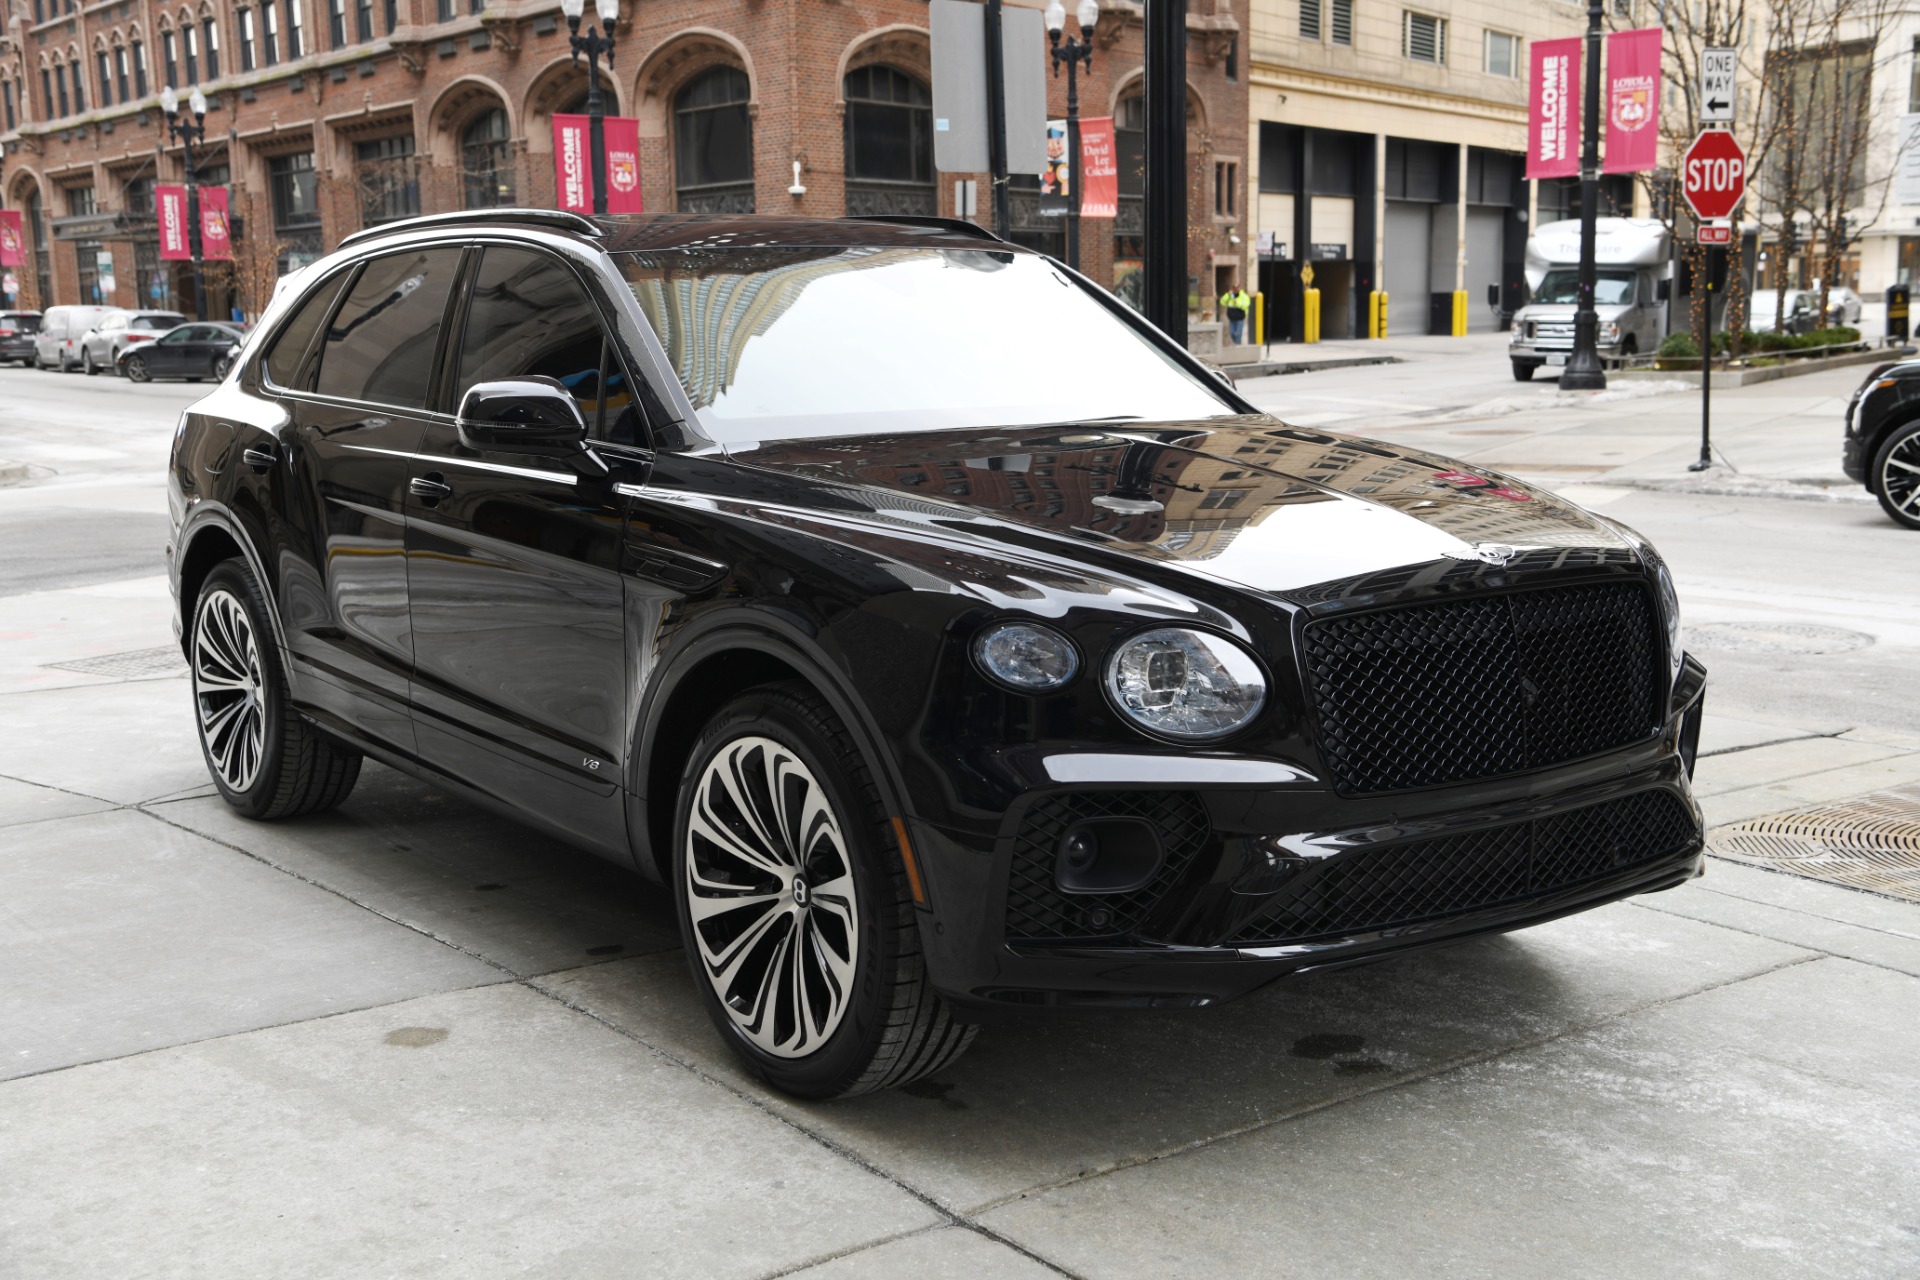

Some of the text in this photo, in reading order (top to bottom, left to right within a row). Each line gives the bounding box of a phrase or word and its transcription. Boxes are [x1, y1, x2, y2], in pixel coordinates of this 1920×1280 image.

[1705, 56, 1732, 72] ONE
[1613, 76, 1654, 88] LOYOLA
[1705, 76, 1732, 92] WAY
[1541, 56, 1558, 161] WELCOME
[1558, 55, 1568, 160] WATER TOWER CAMPUS
[563, 127, 577, 207] WELCOME
[1687, 158, 1743, 192] STOP
[163, 194, 177, 251] WELCOME
[1701, 229, 1728, 240] ALL WAY
[583, 757, 600, 770] V8
